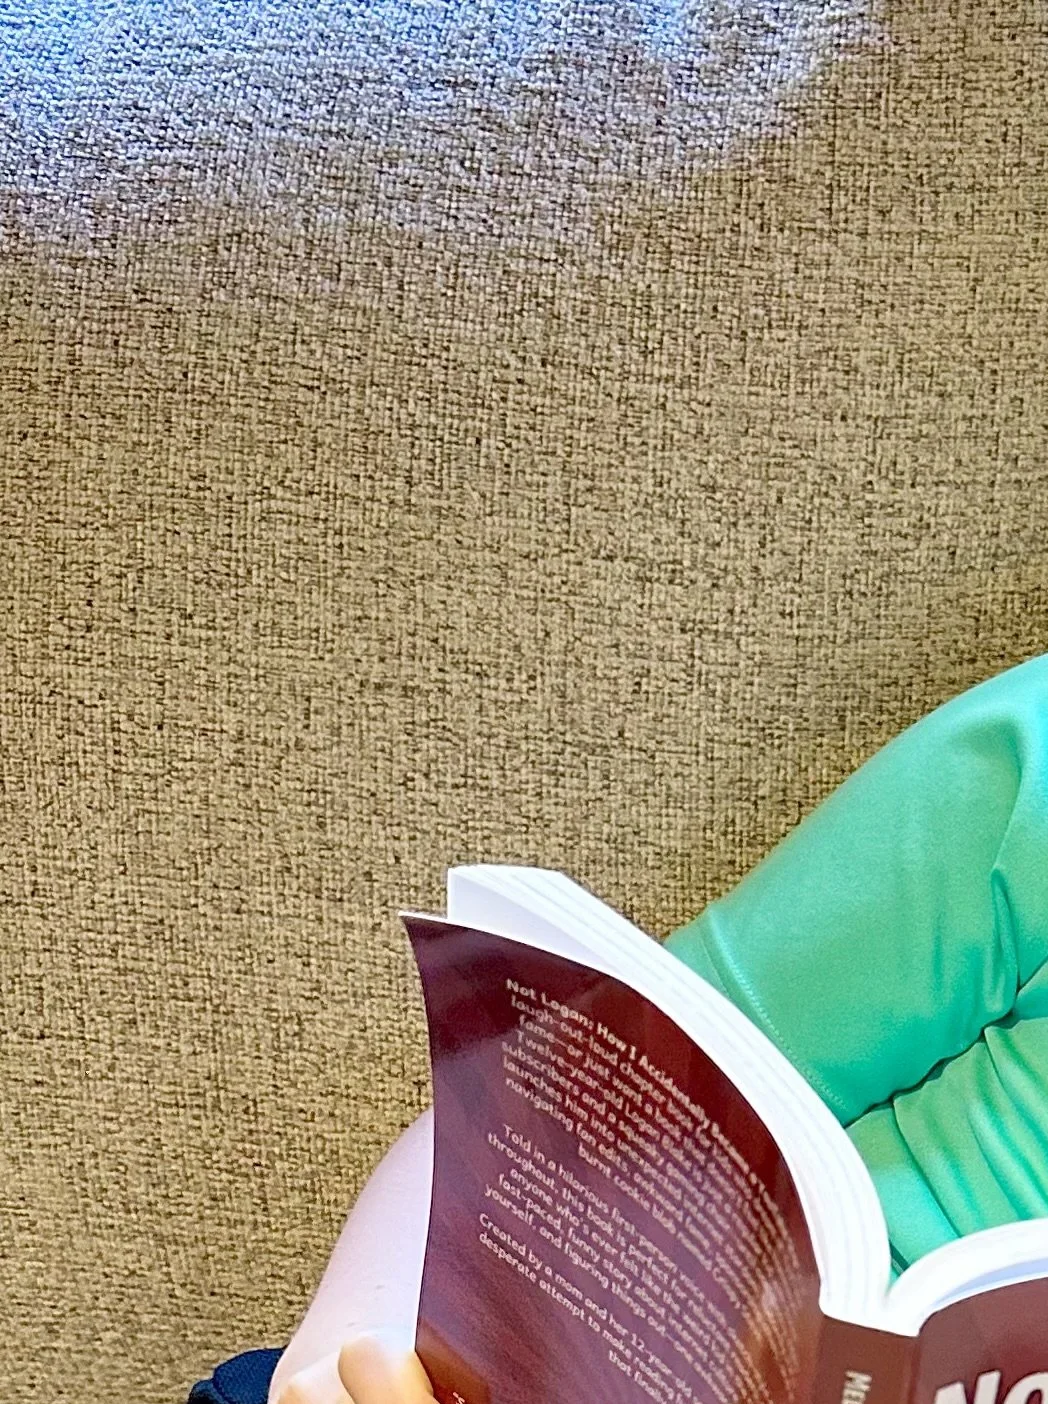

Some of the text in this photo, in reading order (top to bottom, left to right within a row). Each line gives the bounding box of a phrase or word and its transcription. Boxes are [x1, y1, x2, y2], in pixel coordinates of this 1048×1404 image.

[501, 1041, 617, 1124] subscribers and a
[503, 1055, 615, 1142] launches him into
[505, 1077, 574, 1132] navigating
[576, 1122, 597, 1147] fan
[506, 978, 537, 1001] Not
[597, 1022, 627, 1052] How
[629, 1045, 637, 1061] I
[749, 1172, 760, 1185] a
[583, 1054, 610, 1081] just
[612, 1076, 643, 1107] want
[644, 1103, 653, 1115] a
[654, 1107, 681, 1141] book
[619, 1062, 666, 1103] chapter
[624, 1103, 660, 1140] Logan
[503, 1123, 532, 1153] Told
[533, 1145, 546, 1164] in
[547, 1160, 557, 1172] a
[558, 1164, 609, 1213] hilarious
[578, 1143, 611, 1179] burnt
[510, 1168, 553, 1206] anyone
[591, 1232, 618, 1255] ever
[562, 1187, 585, 1212] this
[586, 1205, 614, 1237] book
[616, 1231, 626, 1247] is
[567, 1227, 601, 1263] funny
[479, 1213, 527, 1256] Created
[528, 1249, 543, 1271] by
[544, 1266, 553, 1278] a
[555, 1274, 583, 1300] mom
[584, 1298, 608, 1320] and
[608, 1313, 629, 1336] her
[539, 1226, 562, 1249] and
[564, 1242, 609, 1289] figuring
[611, 1282, 646, 1318] things
[479, 1232, 675, 1400] desperate attempt to make reading
[608, 1350, 632, 1377] that
